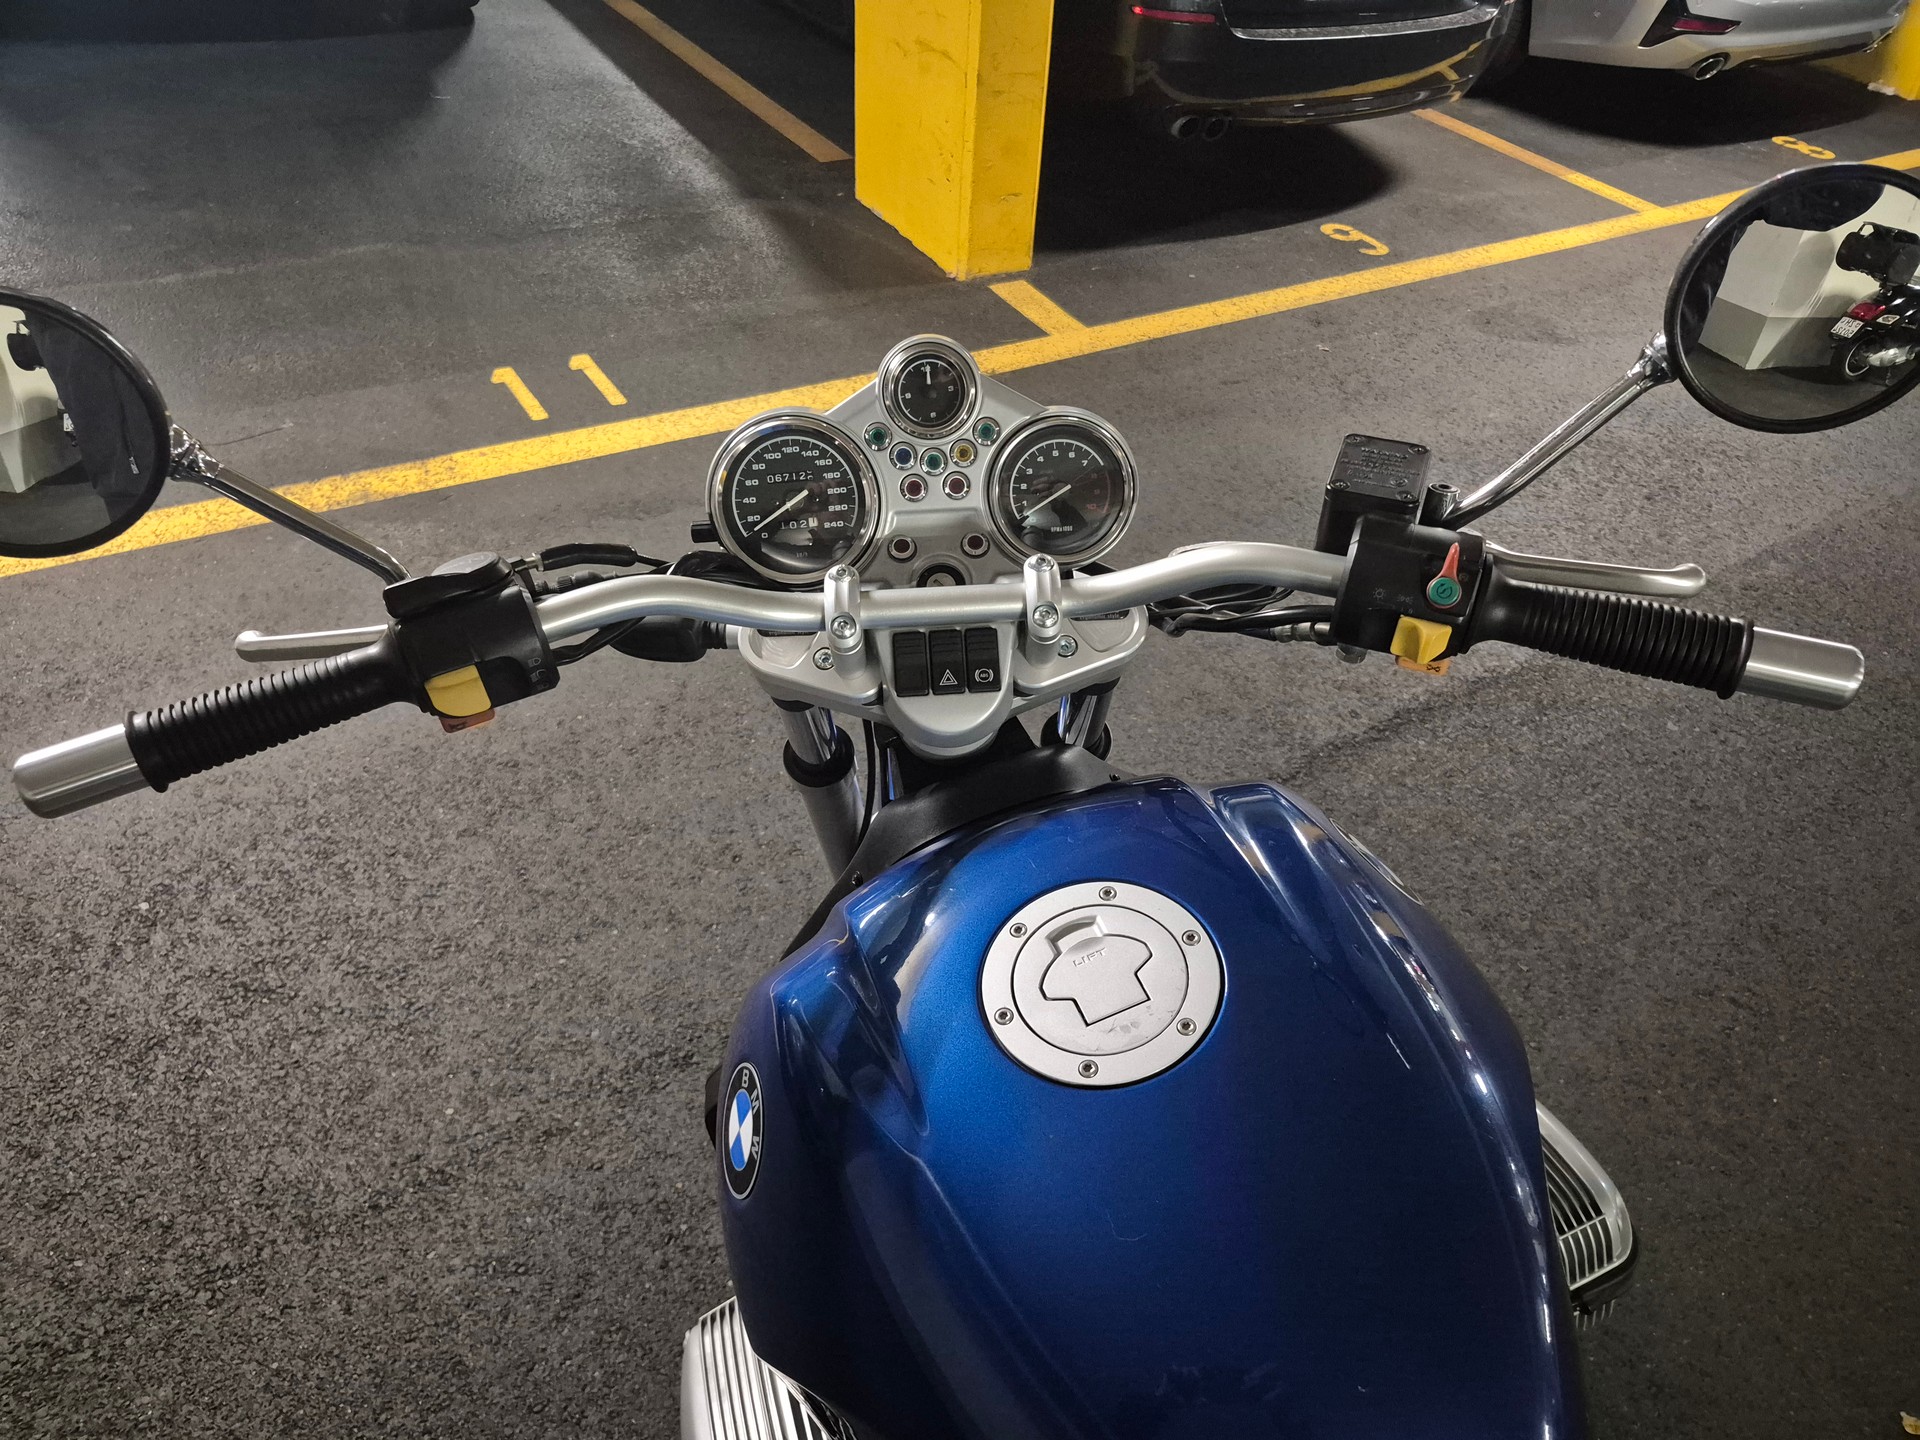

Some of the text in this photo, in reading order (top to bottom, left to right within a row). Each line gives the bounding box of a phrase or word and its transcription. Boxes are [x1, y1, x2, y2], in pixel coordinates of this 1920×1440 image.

[1772, 135, 1836, 160] 8
[1319, 222, 1390, 256] 9
[490, 352, 629, 421] 11
[1072, 947, 1106, 967] LIFT
[741, 1068, 760, 1161] BMW
